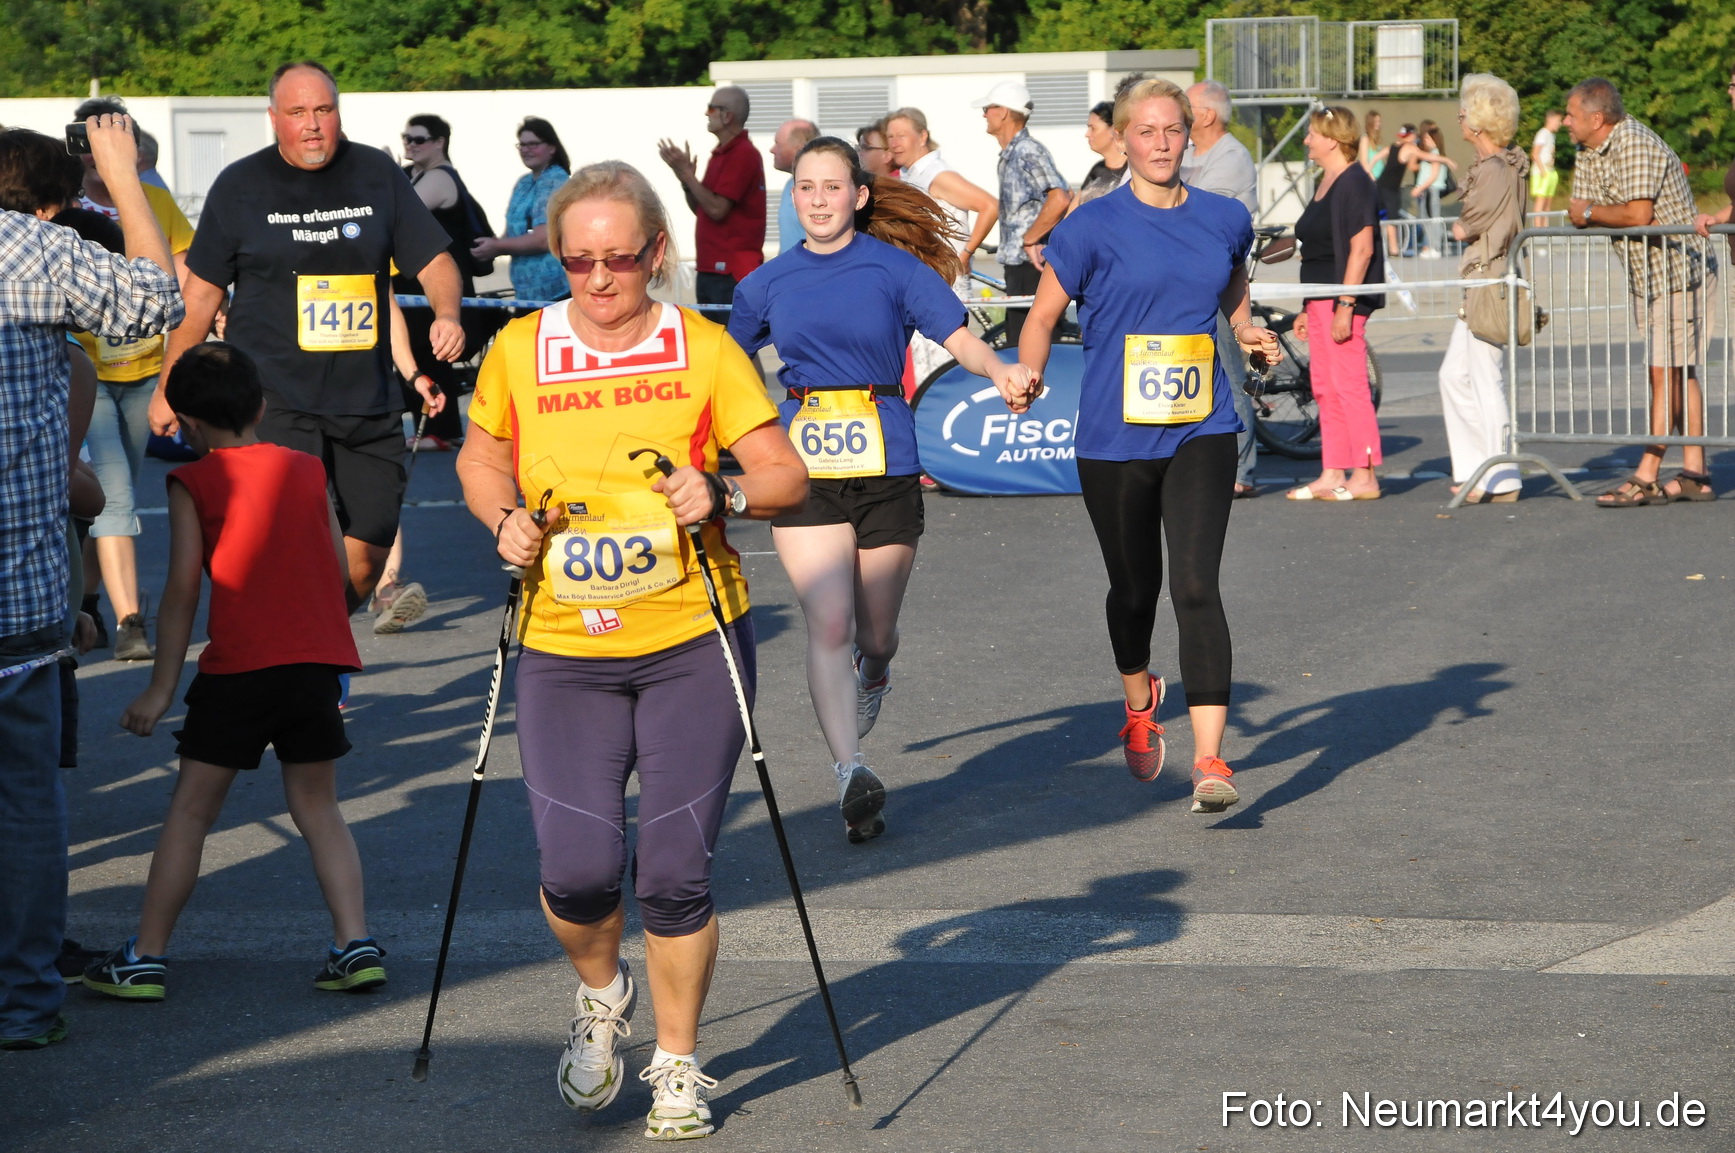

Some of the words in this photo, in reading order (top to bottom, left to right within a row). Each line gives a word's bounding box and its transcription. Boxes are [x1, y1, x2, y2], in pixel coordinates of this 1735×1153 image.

[267, 212, 301, 224] ohne
[302, 205, 374, 223] erkennbare
[291, 226, 339, 244] Mängel
[302, 301, 374, 331] 1412
[537, 389, 604, 415] MAX
[614, 379, 691, 407] BÖGL
[1138, 365, 1201, 401] 650
[801, 420, 868, 456] 656
[980, 410, 1080, 447] Fisc
[563, 535, 658, 582] 803
[571, 593, 587, 601] Bögl
[588, 592, 624, 600] Bauservice
[625, 586, 646, 596] GmbH
[667, 577, 677, 585] KG
[619, 578, 640, 589] Dirigl
